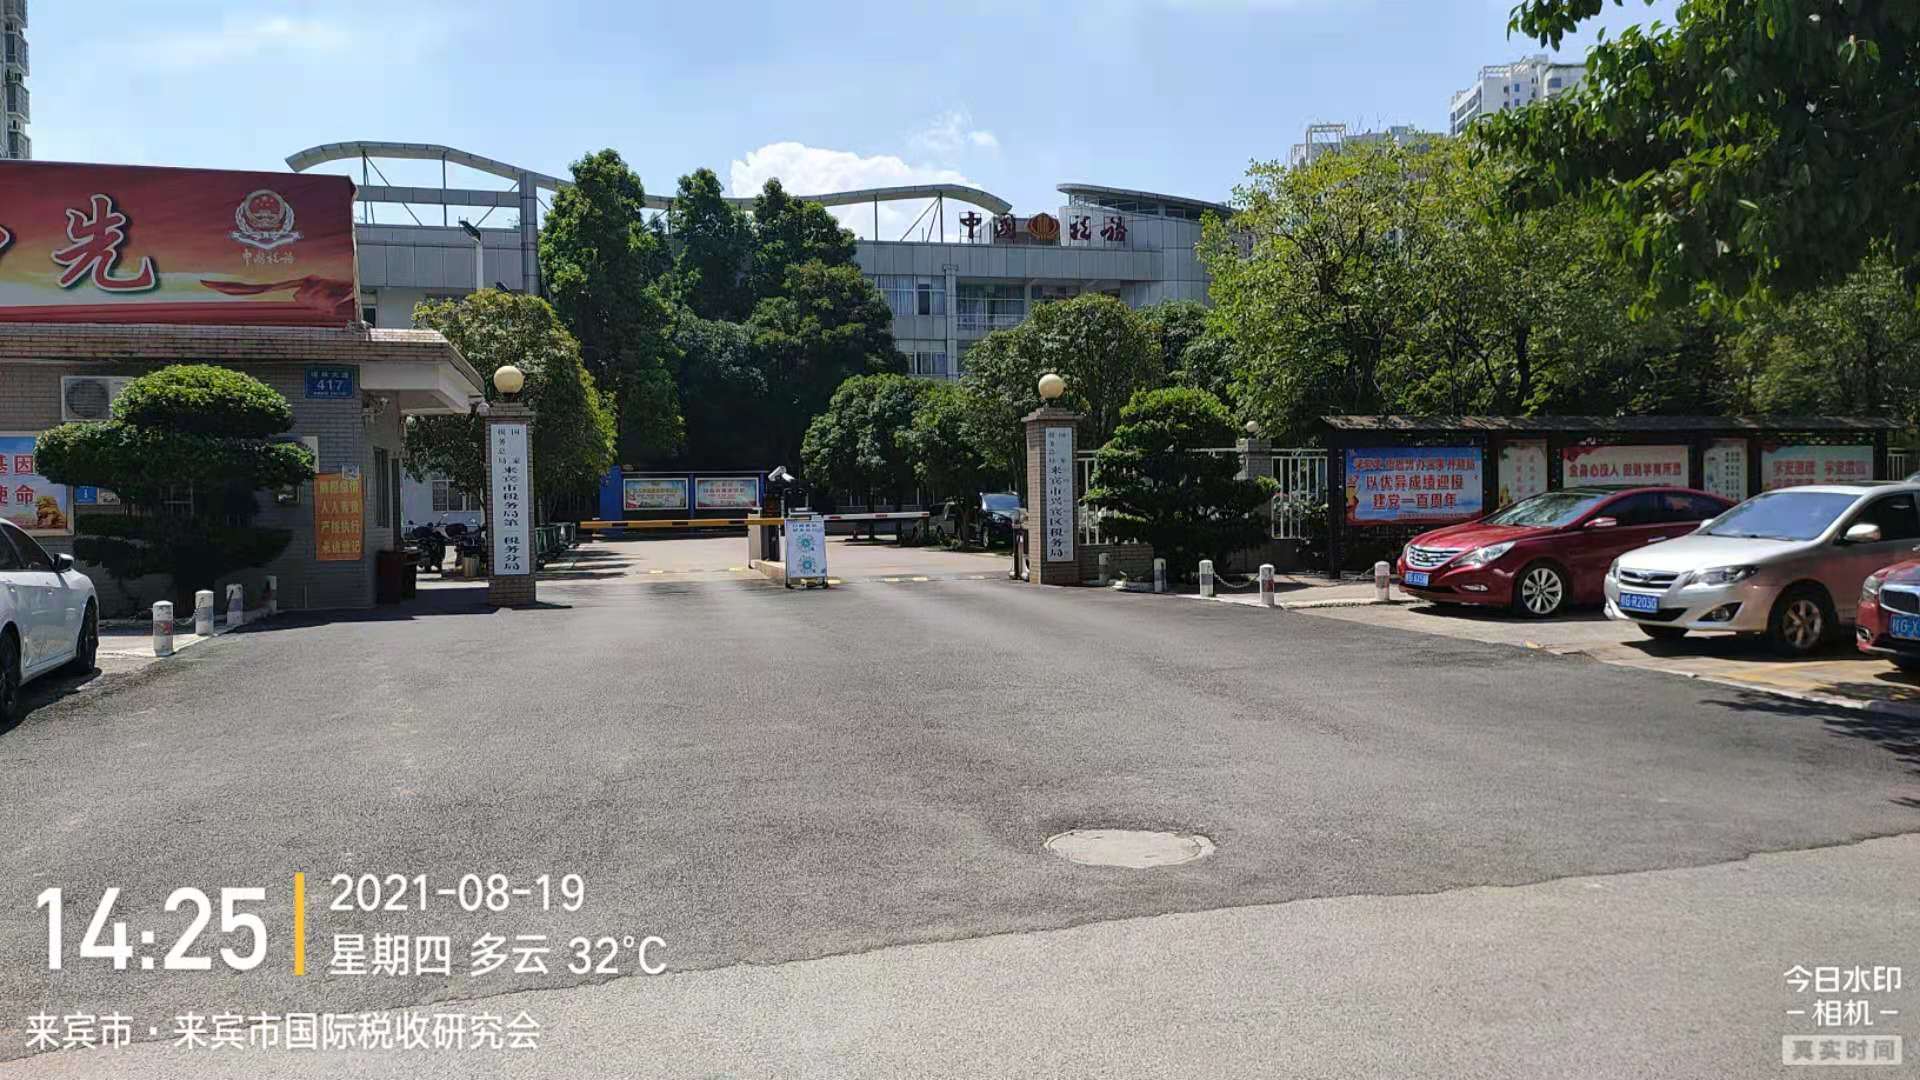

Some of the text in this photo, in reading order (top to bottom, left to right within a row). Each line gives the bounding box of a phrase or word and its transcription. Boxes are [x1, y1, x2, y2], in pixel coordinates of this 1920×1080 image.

[317, 379, 344, 391] 417
[1373, 492, 1457, 511] 建党一百周年
